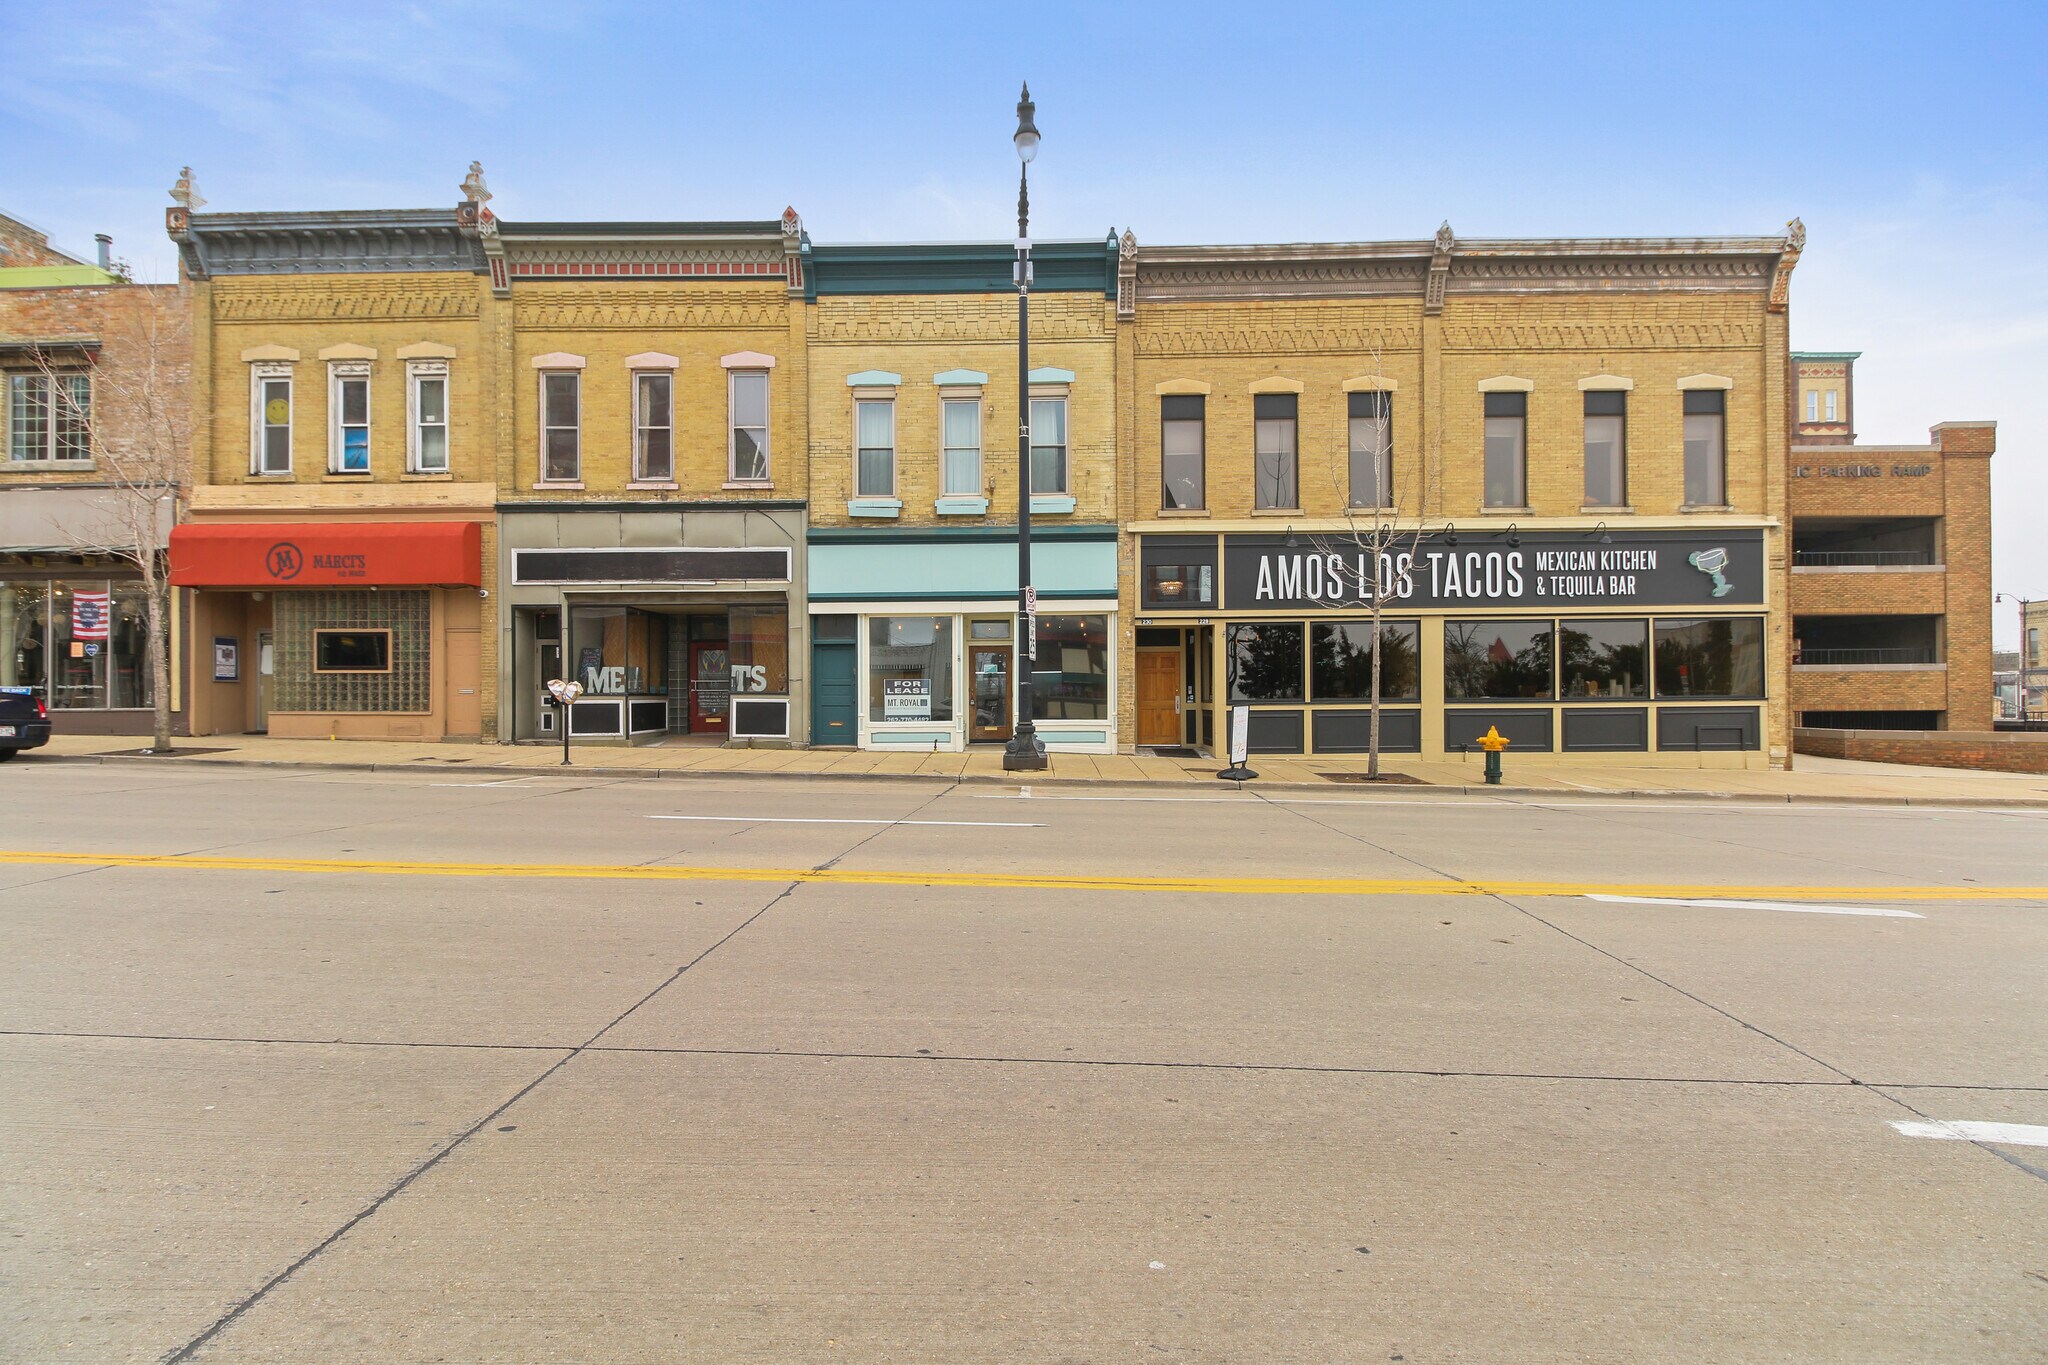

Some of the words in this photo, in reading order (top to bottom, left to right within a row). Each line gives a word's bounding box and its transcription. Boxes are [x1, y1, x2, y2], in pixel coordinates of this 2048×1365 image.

[1820, 465, 1881, 478] PARKING
[1891, 465, 1931, 477] RAMP
[313, 554, 366, 569] MARCI'S
[1536, 551, 1596, 571] MEXICAN
[1600, 550, 1657, 570] KITCHEN
[1255, 554, 1343, 600] AMOS
[1358, 553, 1413, 599] LOS
[1426, 552, 1523, 598] TACOS
[1536, 576, 1546, 596] &
[1550, 576, 1605, 597] TEQUILA
[1609, 575, 1636, 595] BAR
